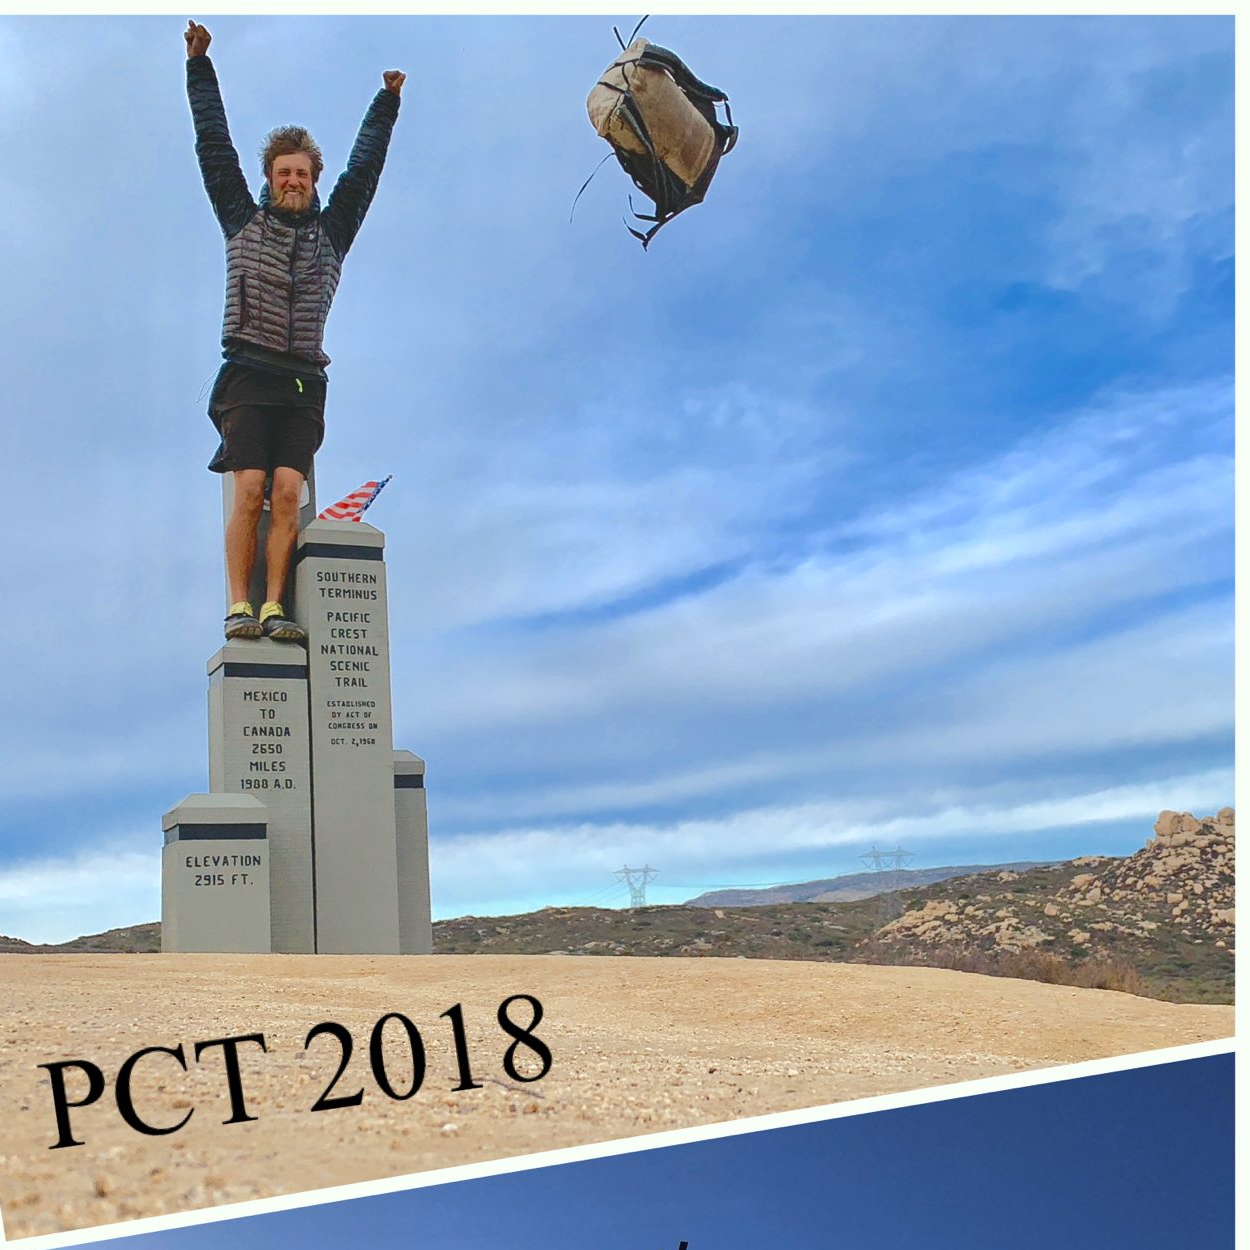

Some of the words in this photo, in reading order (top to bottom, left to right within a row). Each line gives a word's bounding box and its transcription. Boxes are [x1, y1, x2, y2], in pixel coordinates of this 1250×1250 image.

[316, 572, 377, 584] SOUTHERN
[319, 588, 377, 600] TERMINUS
[327, 612, 371, 623] PACIFIC
[331, 628, 367, 639] CREST
[320, 644, 379, 657] NATIONAL
[330, 660, 370, 672] SCENIC
[335, 677, 368, 688] TRAIL
[243, 691, 288, 702] MEXICO
[327, 700, 376, 708] ESTABLISHED
[260, 708, 275, 719] TO
[346, 711, 359, 719] ACT
[243, 726, 291, 737] CANADA
[328, 722, 365, 730] CONGRESS
[252, 743, 283, 754] 2650
[250, 761, 286, 772] MILES
[240, 778, 269, 790] 1988
[273, 778, 297, 790] A.D.
[185, 855, 262, 868] ELEVATION
[195, 874, 225, 886] 2915
[231, 873, 254, 886] FT.
